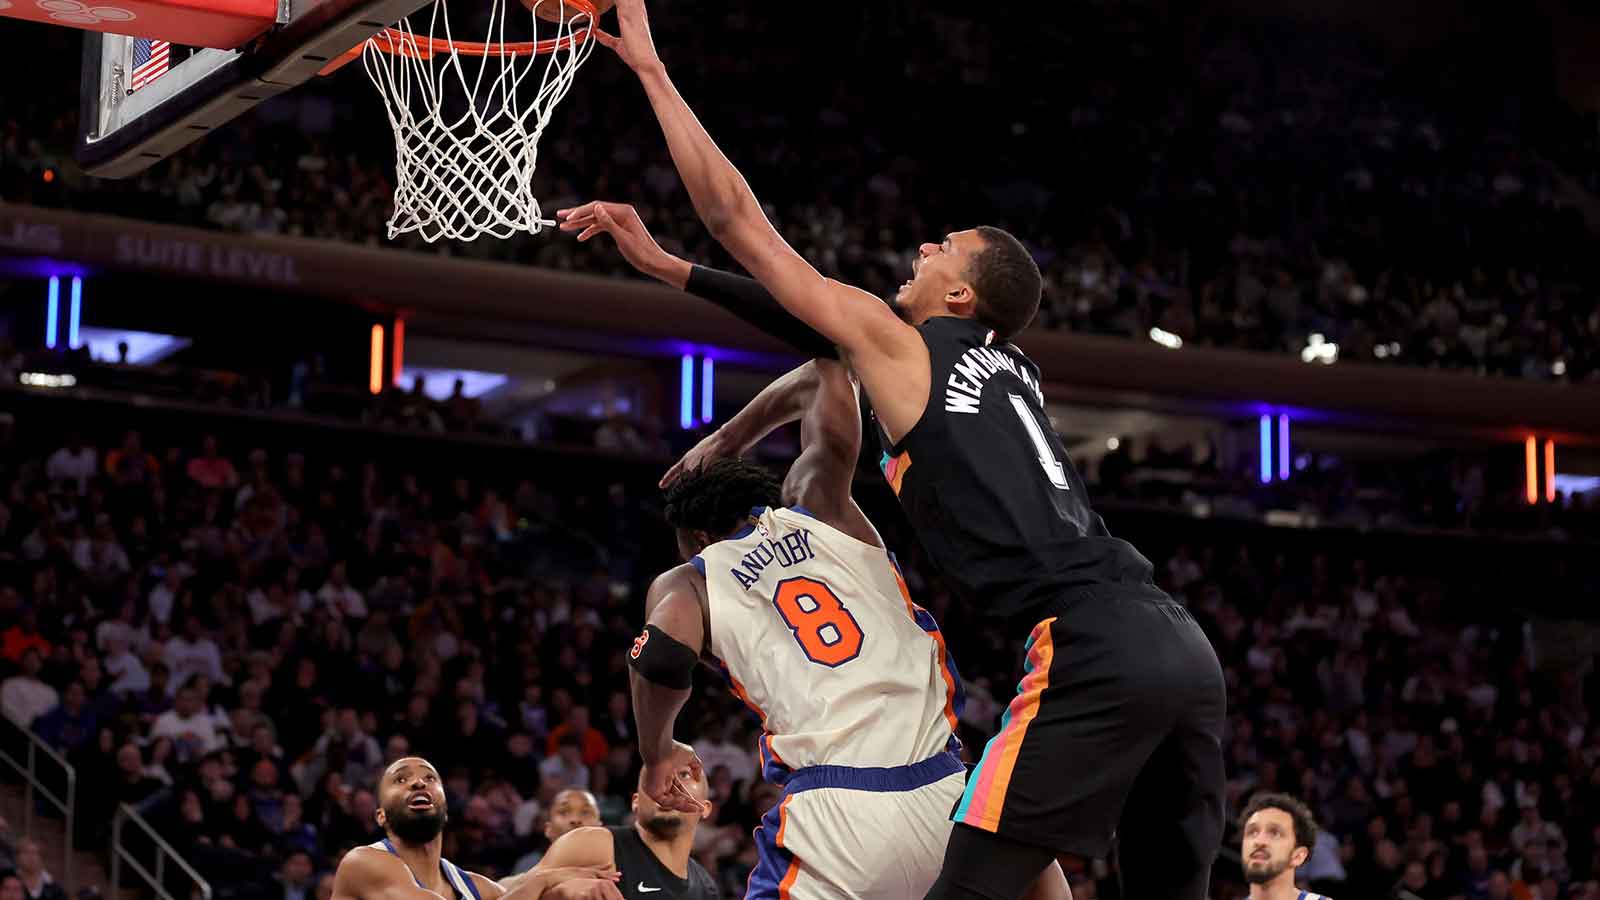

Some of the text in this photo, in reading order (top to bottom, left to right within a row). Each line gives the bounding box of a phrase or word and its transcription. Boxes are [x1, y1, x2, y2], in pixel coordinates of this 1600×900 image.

[115, 235, 200, 270] SUITE
[211, 246, 299, 283] LEVEL
[1008, 392, 1070, 490] 1
[631, 629, 649, 660] 8
[773, 575, 865, 668] 8
